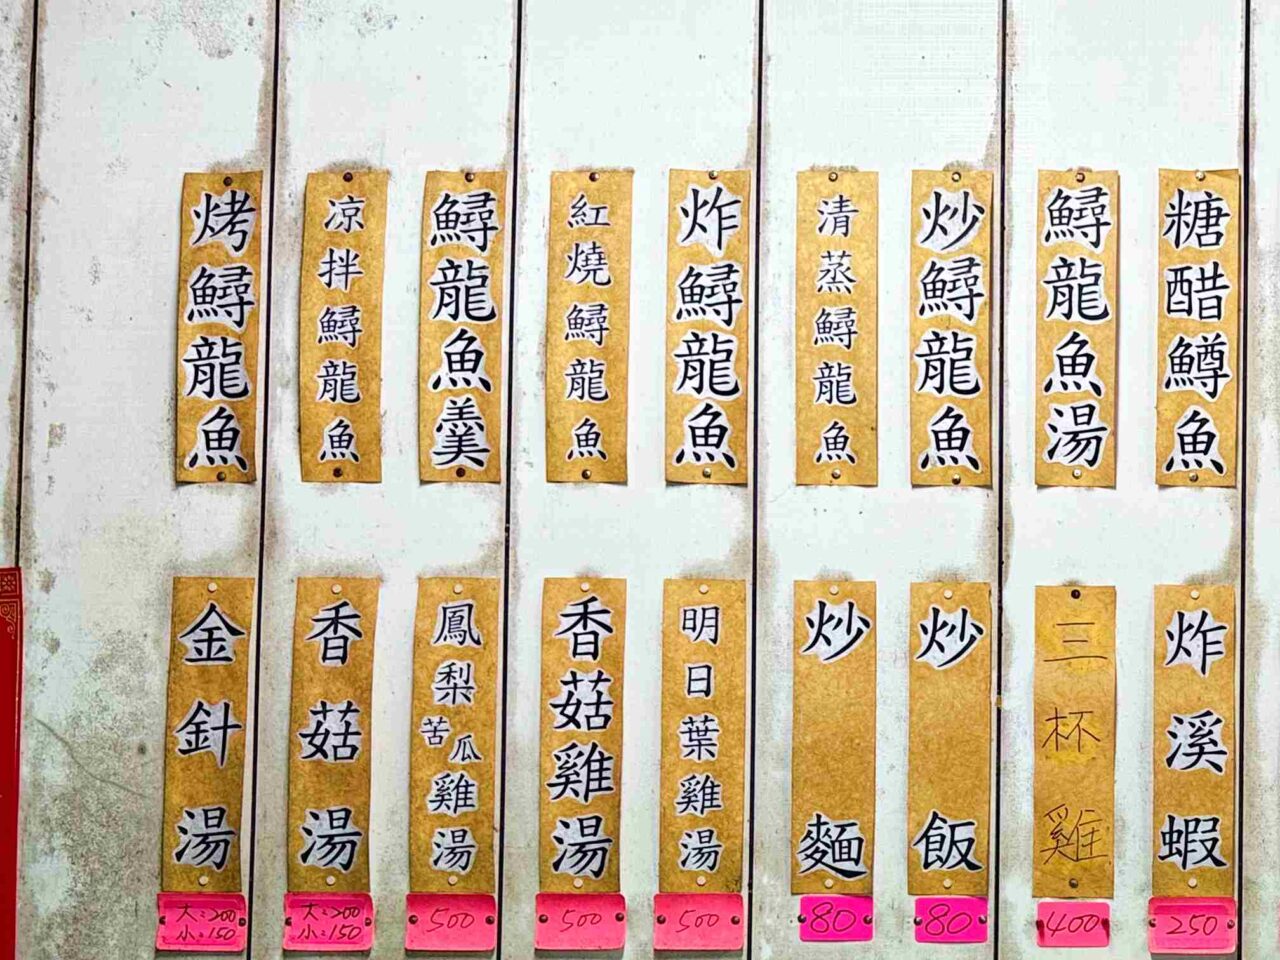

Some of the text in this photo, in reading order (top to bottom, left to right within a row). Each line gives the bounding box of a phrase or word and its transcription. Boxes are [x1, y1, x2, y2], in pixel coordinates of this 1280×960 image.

[182, 191, 257, 467] 烤鱘龍魚
[431, 193, 499, 466] 鱘龍魚羹
[565, 195, 611, 459] 紅燒鱘龍魚
[675, 187, 743, 466] 炸鱘龍魚
[813, 195, 859, 465] 清蒸鱘龍魚
[915, 191, 986, 471] 炒鱘龍魚
[1042, 188, 1110, 465] 鱘龍魚湯
[1162, 189, 1231, 473] 糖醋鱒魚
[174, 603, 245, 869] 金針湯
[299, 601, 362, 869] 香菇湯
[547, 596, 613, 876] 香菇雞湯
[676, 607, 722, 871] 明日葉雞湯
[913, 607, 983, 871] 炒飯
[430, 910, 475, 932] 500
[562, 908, 603, 930] 500
[675, 908, 720, 931] 500
[810, 903, 854, 933] 80
[917, 904, 971, 934] 80
[1046, 912, 1098, 934] 400
[1168, 913, 1216, 936] 250
